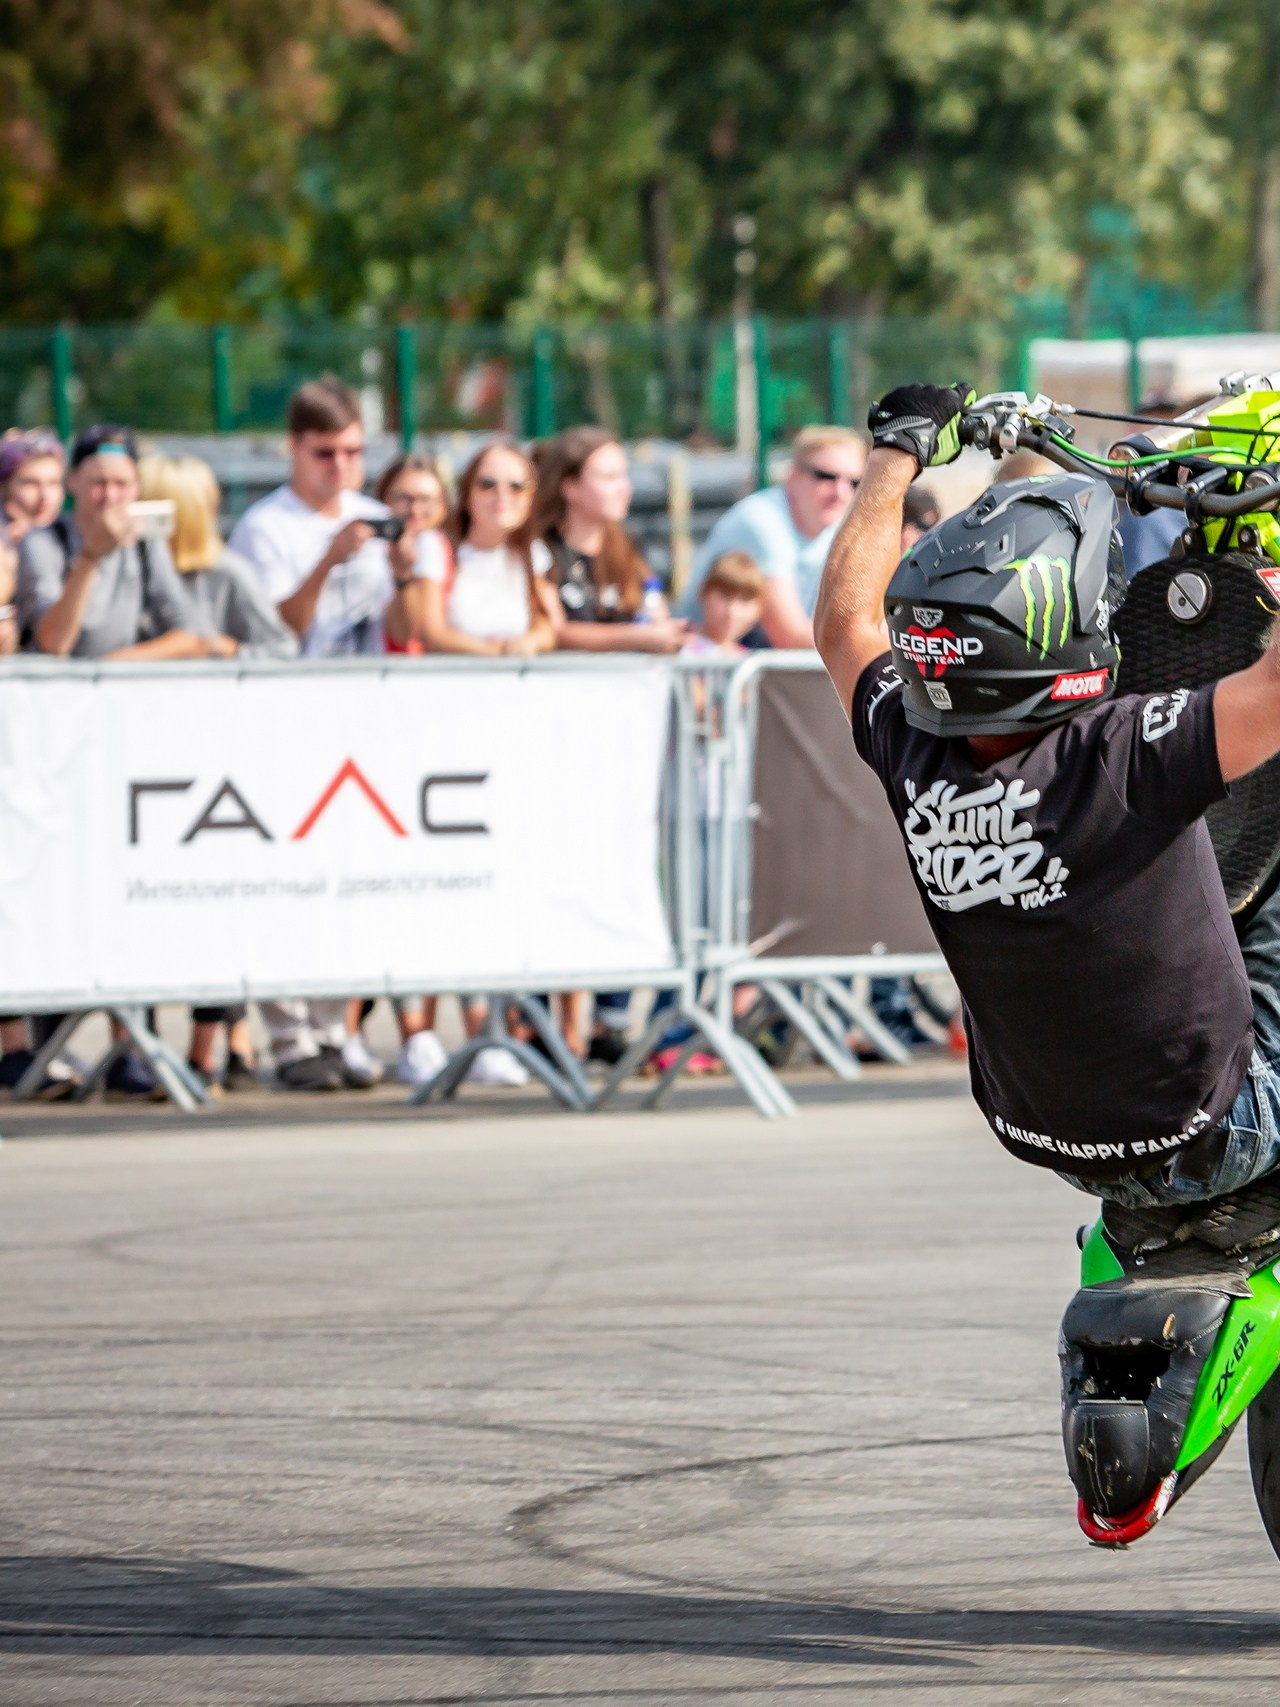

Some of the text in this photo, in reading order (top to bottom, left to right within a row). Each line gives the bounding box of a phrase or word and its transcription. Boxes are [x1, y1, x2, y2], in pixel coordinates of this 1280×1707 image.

[892, 629, 984, 656] LEGEND
[903, 651, 965, 665] STUNT TEAM
[1054, 674, 1105, 697] MOTUL
[127, 755, 490, 846] ГАЛС
[1055, 1141, 1126, 1160] HAPPY
[1211, 1320, 1257, 1411] ZX-6R
